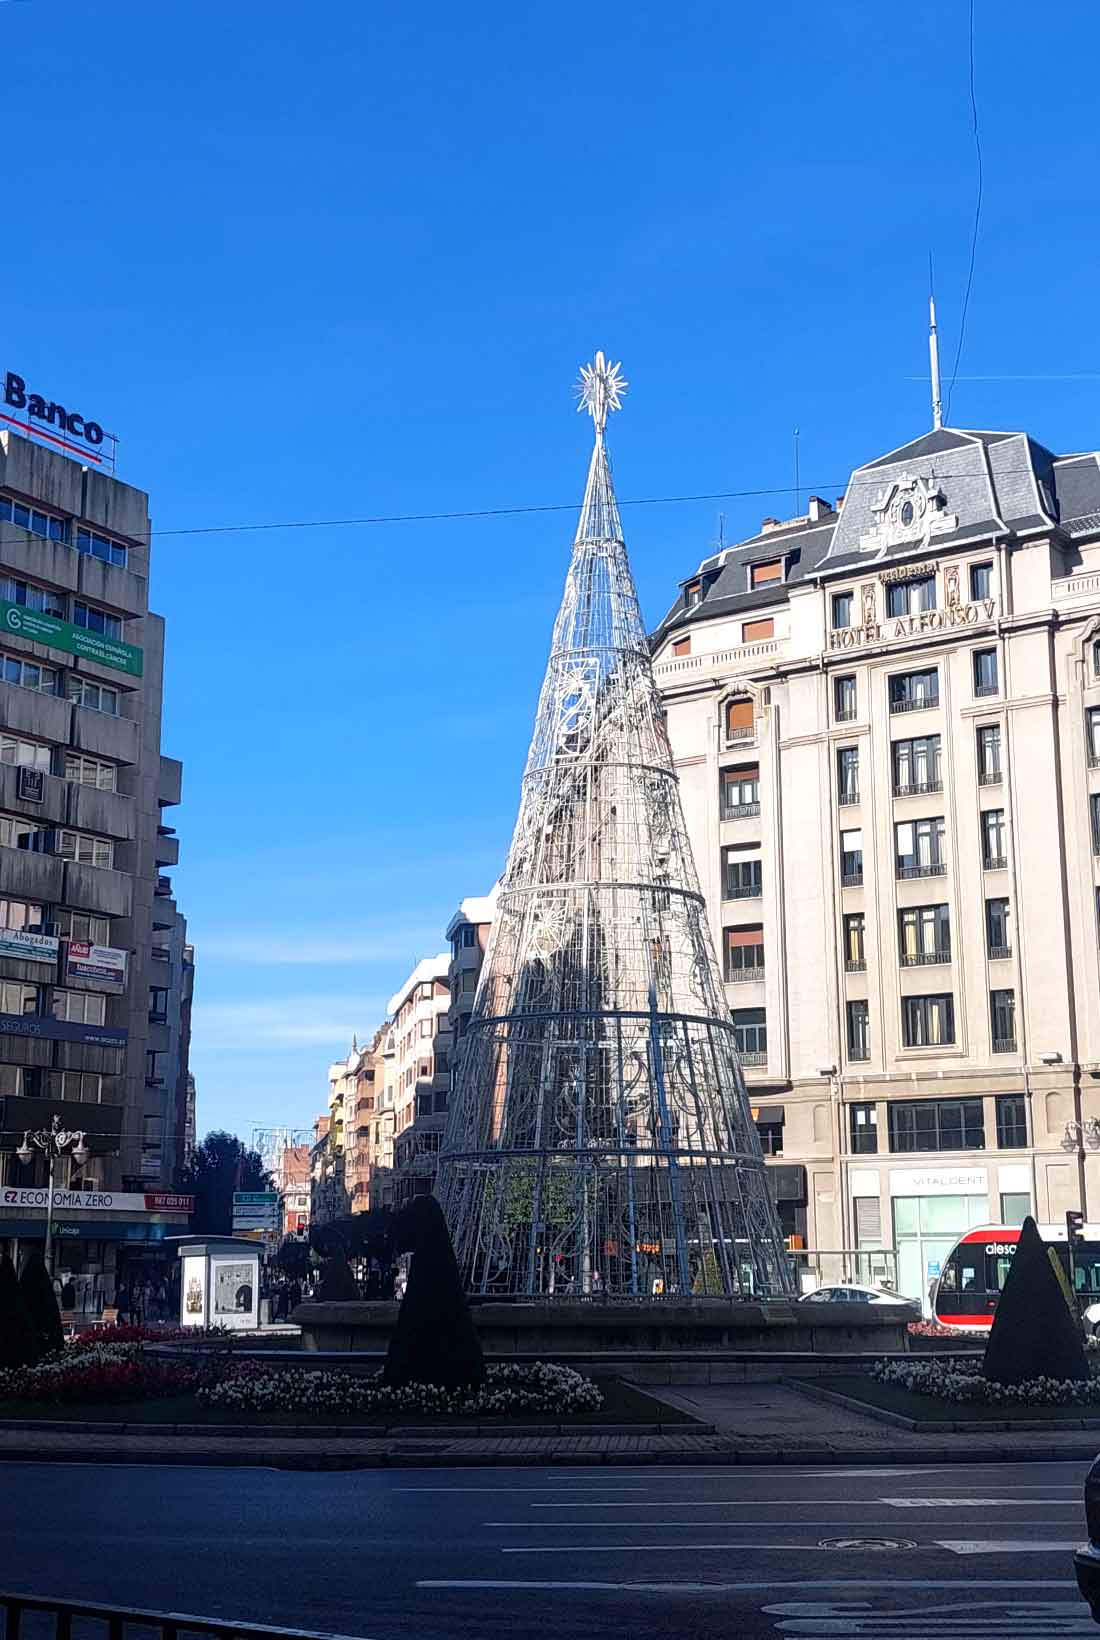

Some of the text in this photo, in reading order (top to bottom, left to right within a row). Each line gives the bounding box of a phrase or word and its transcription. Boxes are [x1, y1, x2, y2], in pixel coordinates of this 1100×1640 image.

[4, 371, 104, 445] Banco
[830, 598, 996, 650] HOTEL ALFONSO V
[13, 930, 53, 946] Abogados
[0, 1018, 41, 1034] SEGUROS
[912, 1175, 985, 1186] VITALDENT
[85, 1193, 113, 1207] ZERO
